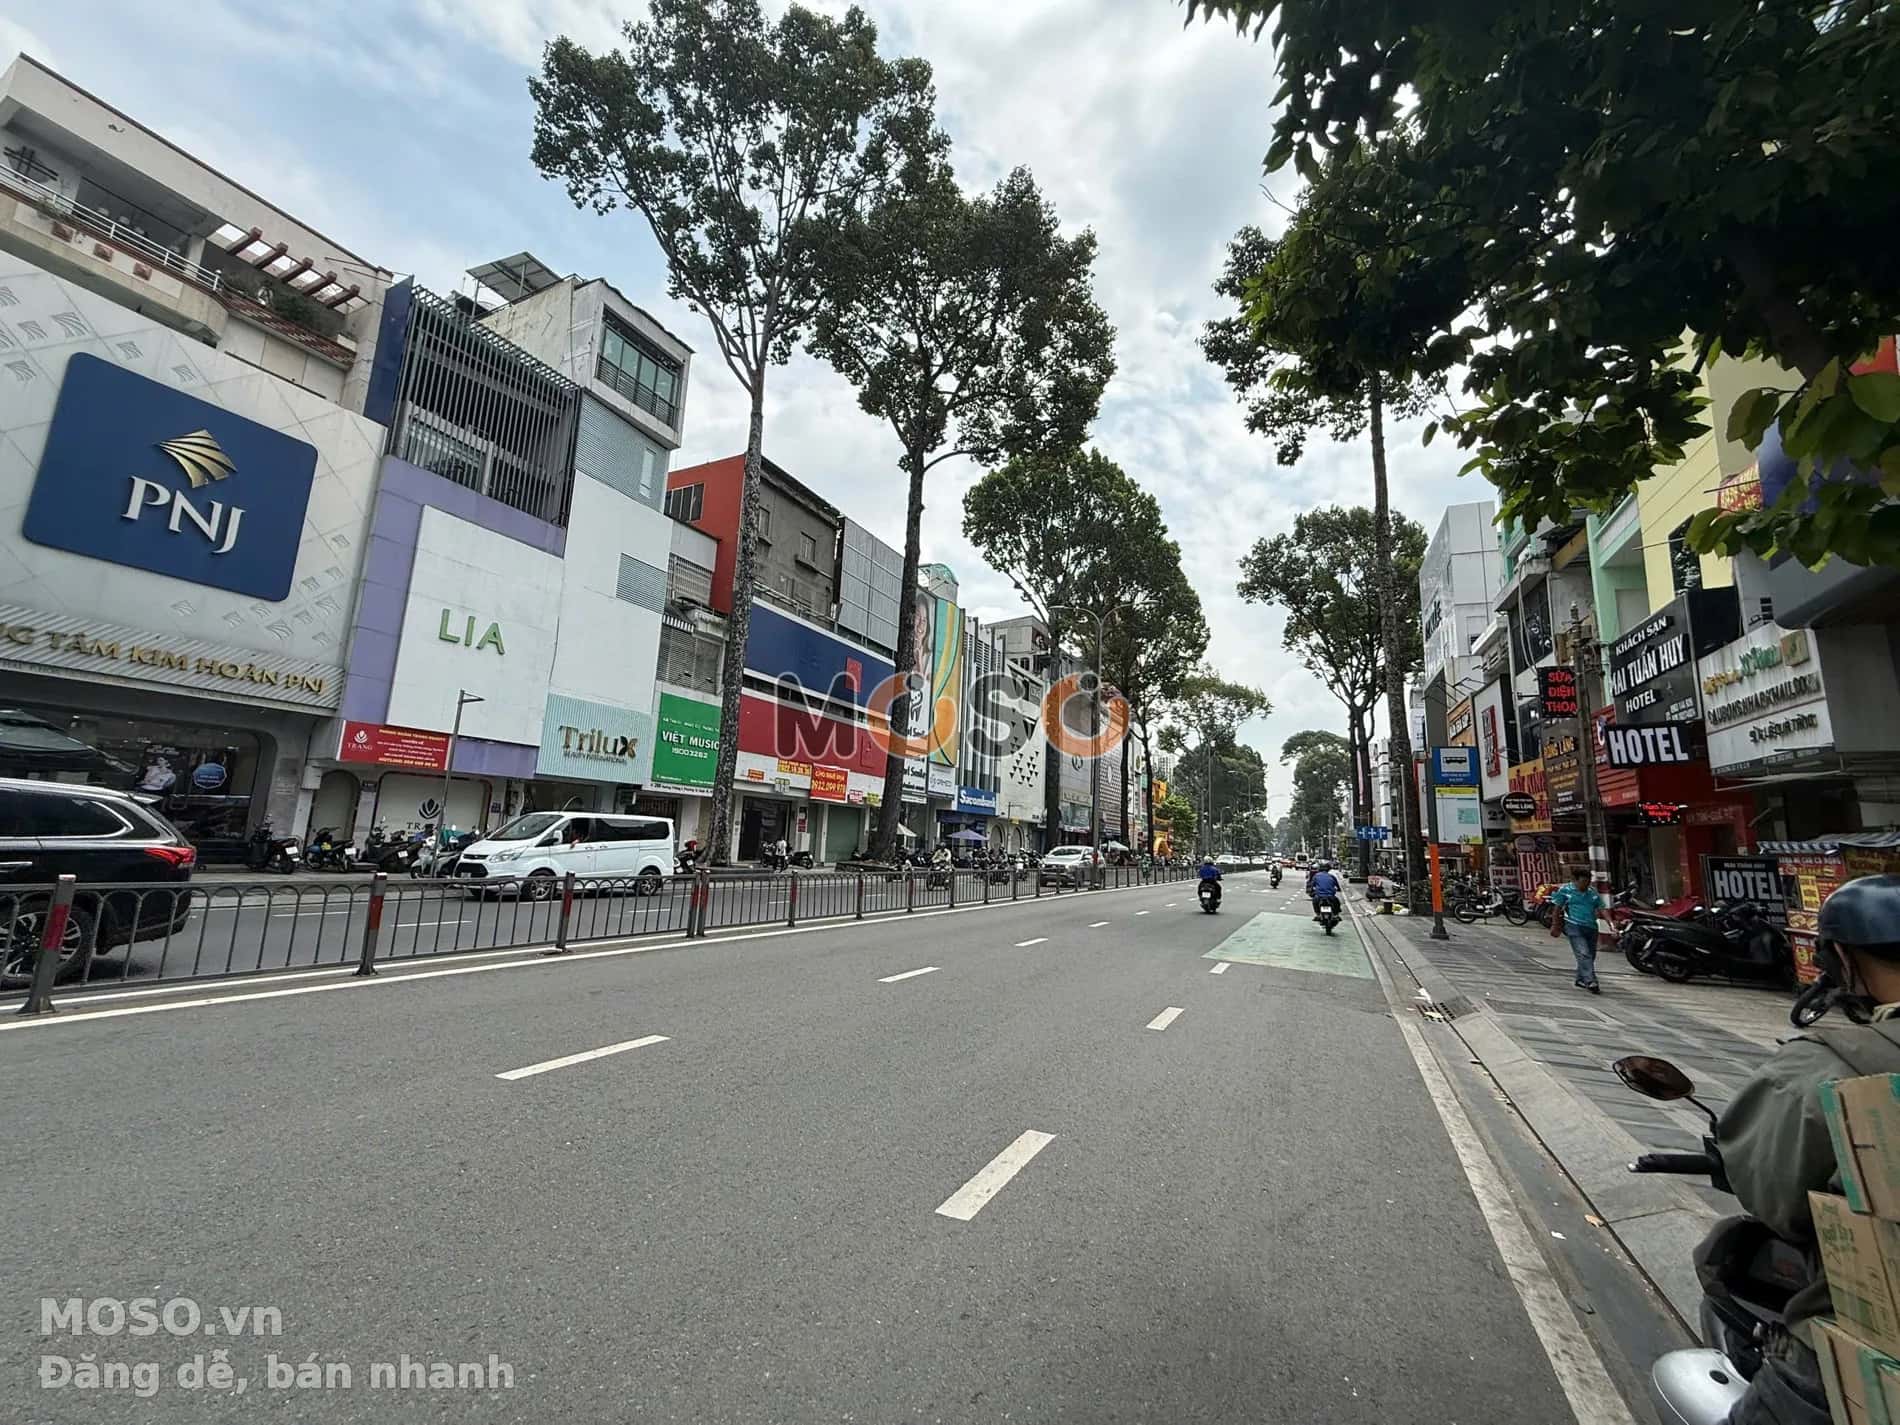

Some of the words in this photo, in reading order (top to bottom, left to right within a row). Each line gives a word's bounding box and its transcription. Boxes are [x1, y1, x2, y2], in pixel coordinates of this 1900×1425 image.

[122, 476, 246, 556] PNJ
[438, 608, 506, 655] LIA
[1615, 629, 1646, 656] KHÁCH
[1646, 615, 1667, 639] SẠN
[48, 632, 120, 660] TÂM
[130, 646, 188, 672] KIM
[196, 657, 279, 687] HOÀN
[285, 673, 327, 695] PNJ
[1659, 633, 1684, 672] HUY
[1625, 689, 1656, 713] HOTEL
[559, 726, 638, 759] Trilux
[1608, 726, 1689, 765] HOTEL
[1713, 870, 1784, 900] HOTEL
